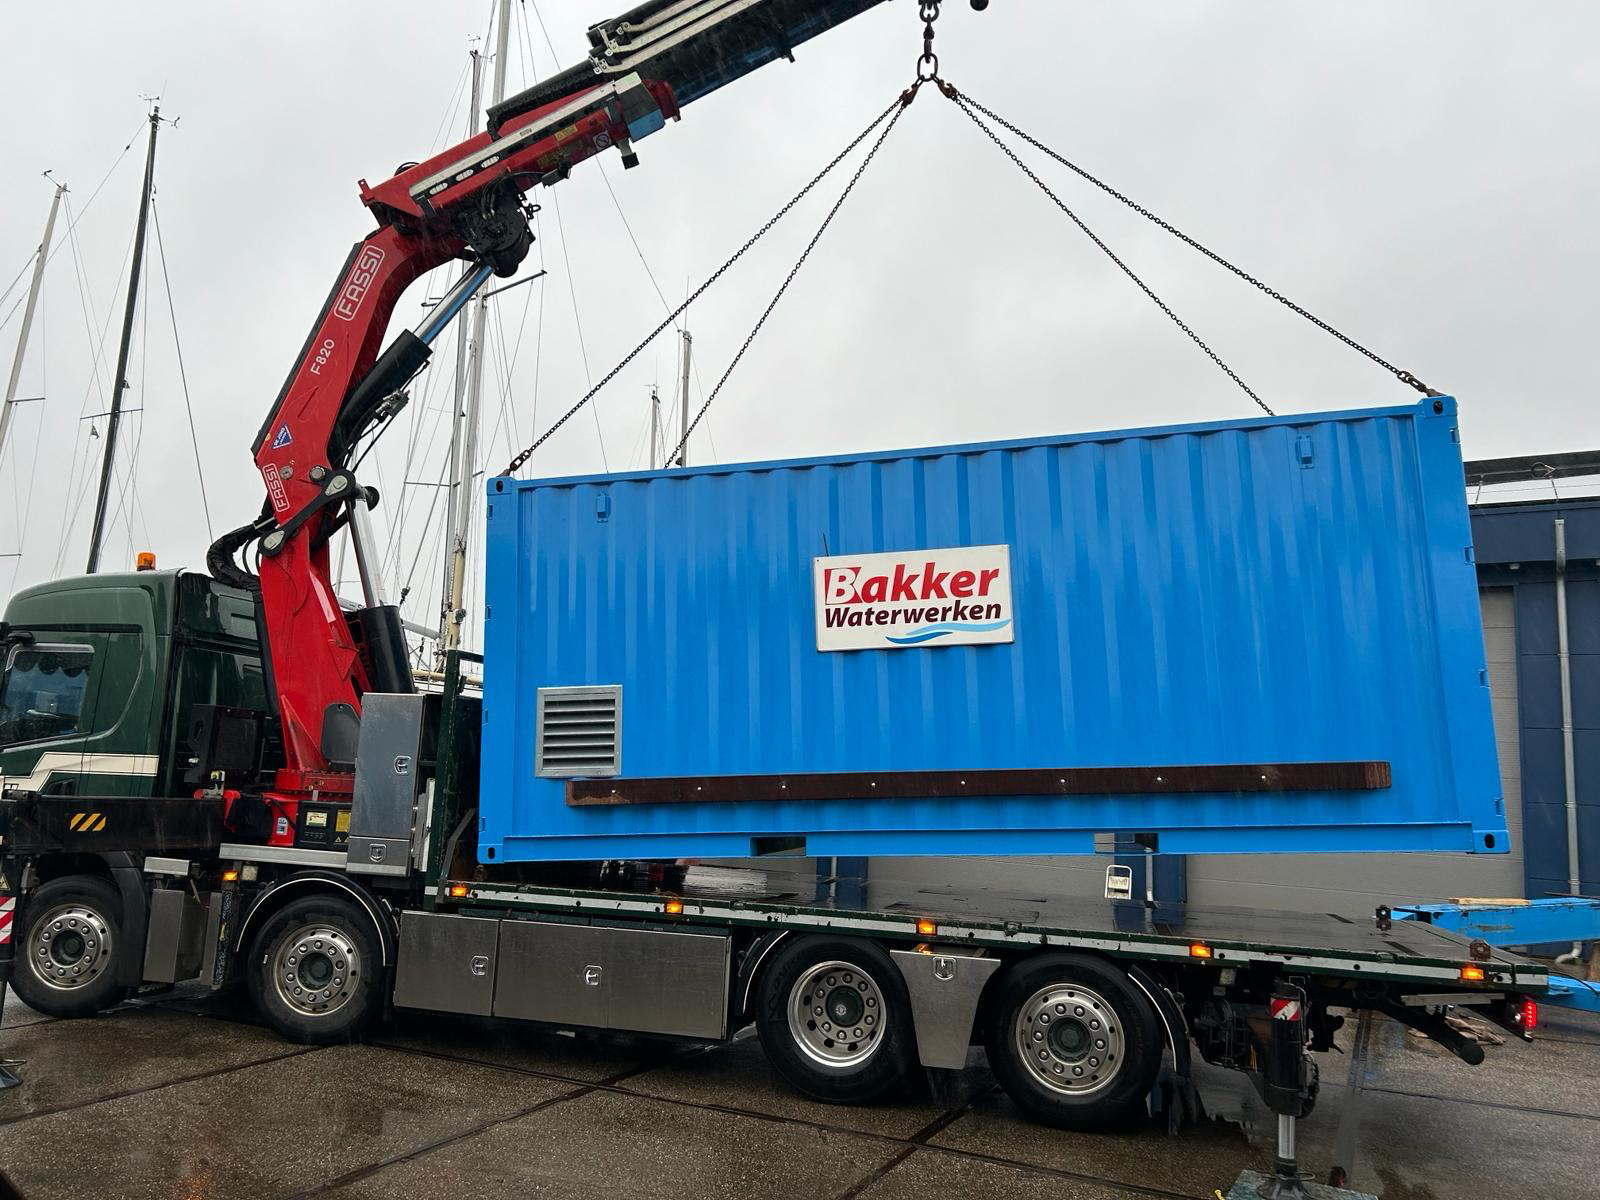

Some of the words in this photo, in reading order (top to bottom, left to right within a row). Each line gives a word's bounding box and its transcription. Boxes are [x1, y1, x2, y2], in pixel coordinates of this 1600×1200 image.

[338, 250, 381, 315] FASSI
[310, 338, 335, 375] F820
[265, 467, 288, 508] FASSI
[824, 561, 1000, 605] Bakker
[825, 599, 1002, 628] Waterwerken
